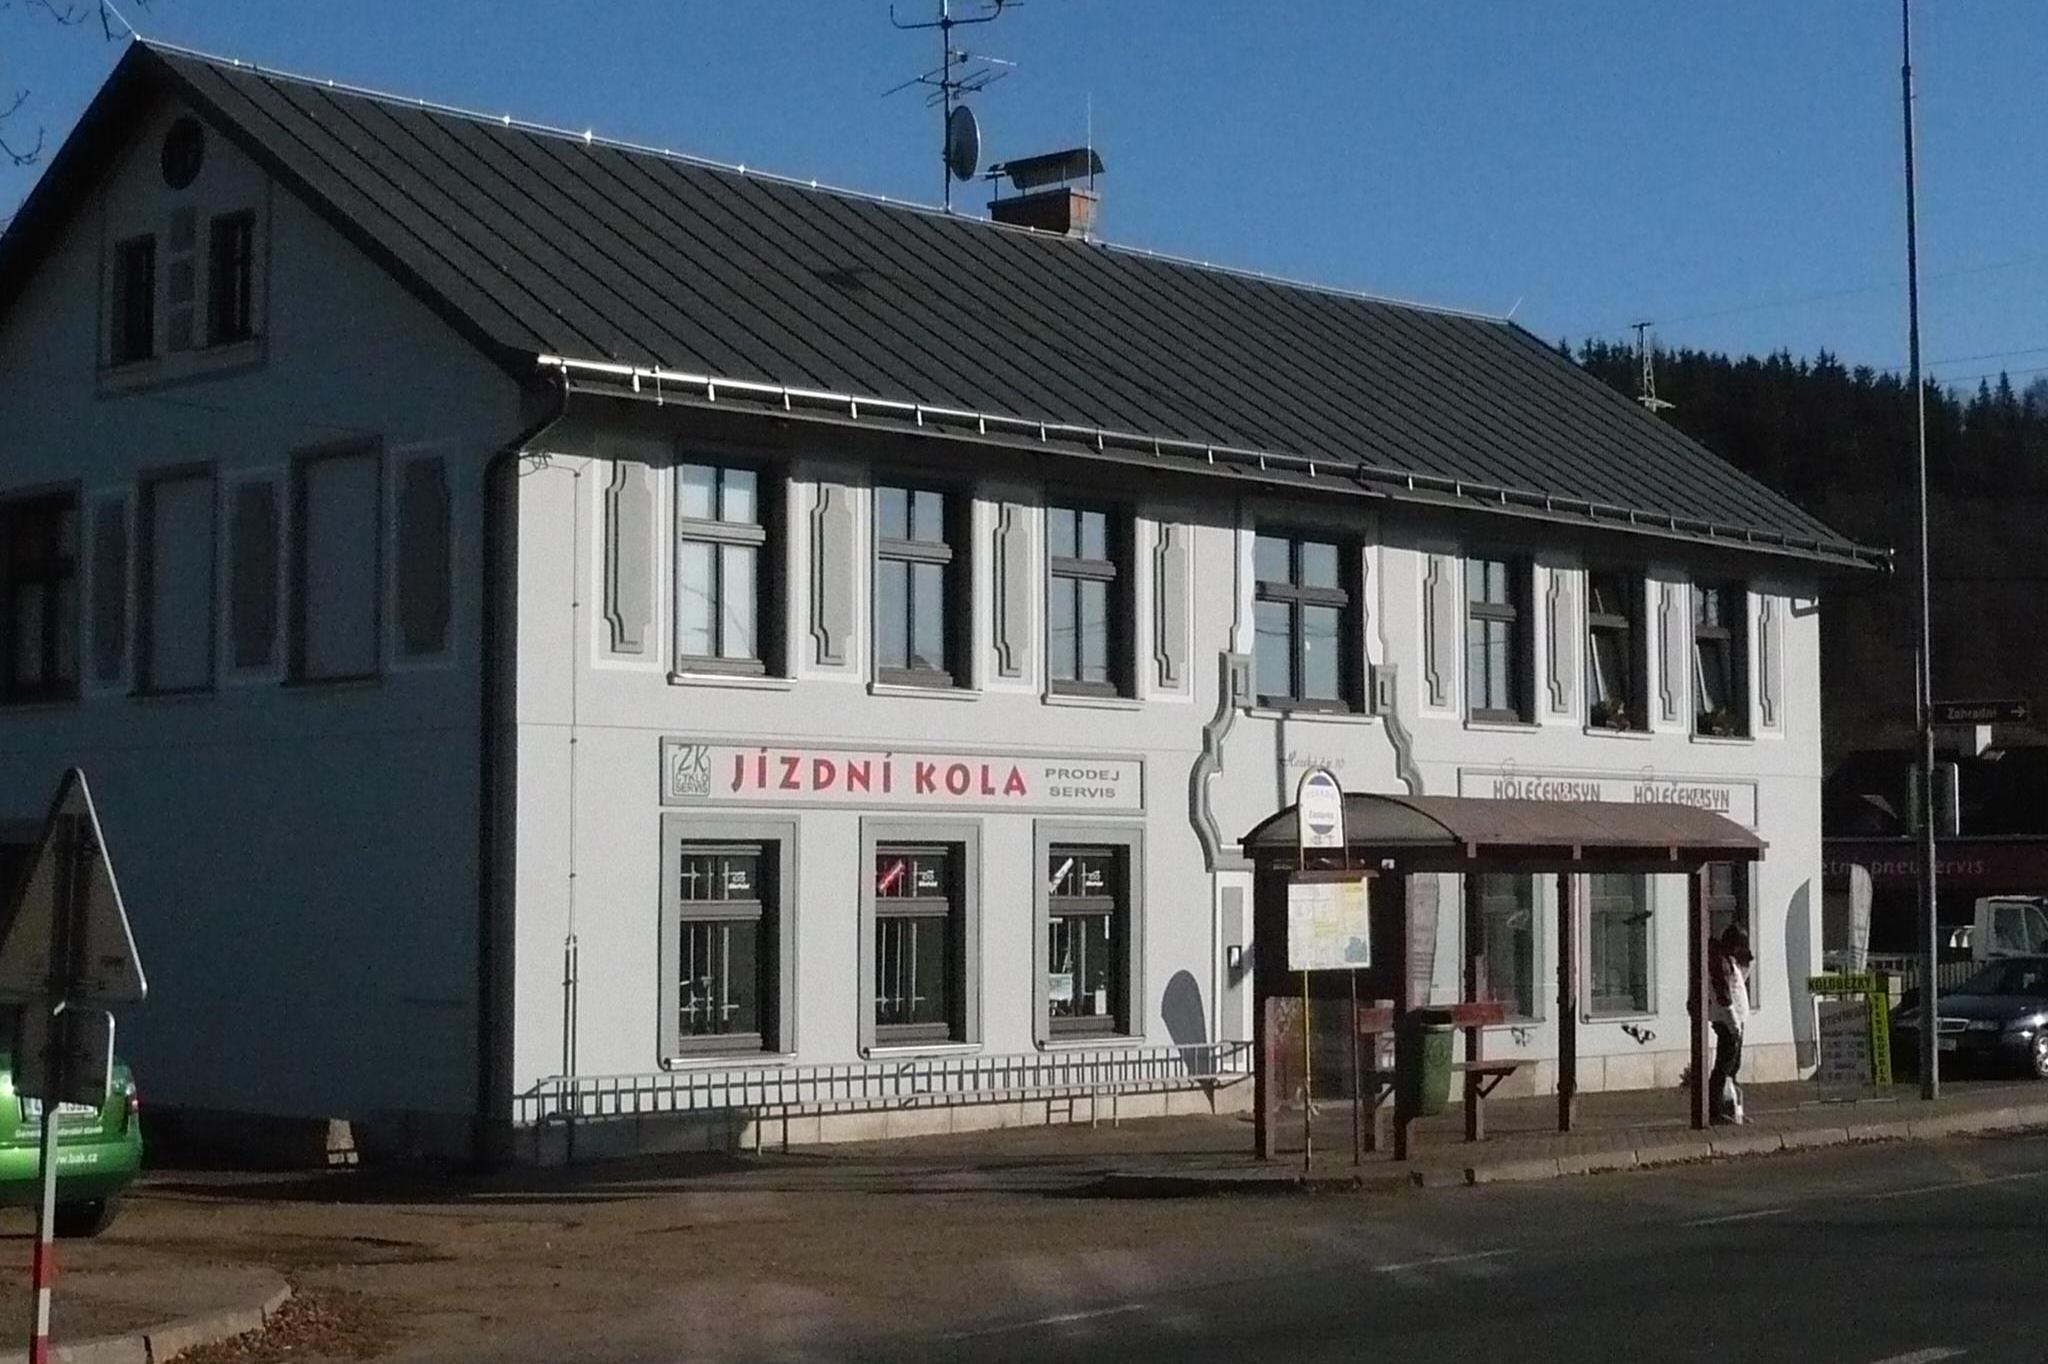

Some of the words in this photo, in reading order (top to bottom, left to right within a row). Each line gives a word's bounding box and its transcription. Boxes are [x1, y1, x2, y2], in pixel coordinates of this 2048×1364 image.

[678, 744, 708, 772] ZK
[731, 746, 892, 793] JÍZDNÍ
[915, 761, 1027, 797] KOLA
[1045, 768, 1120, 781] PRODEJ
[675, 783, 708, 793] SERVIS
[1049, 786, 1116, 799] SERVIS
[1871, 860, 1984, 879] pneuervis
